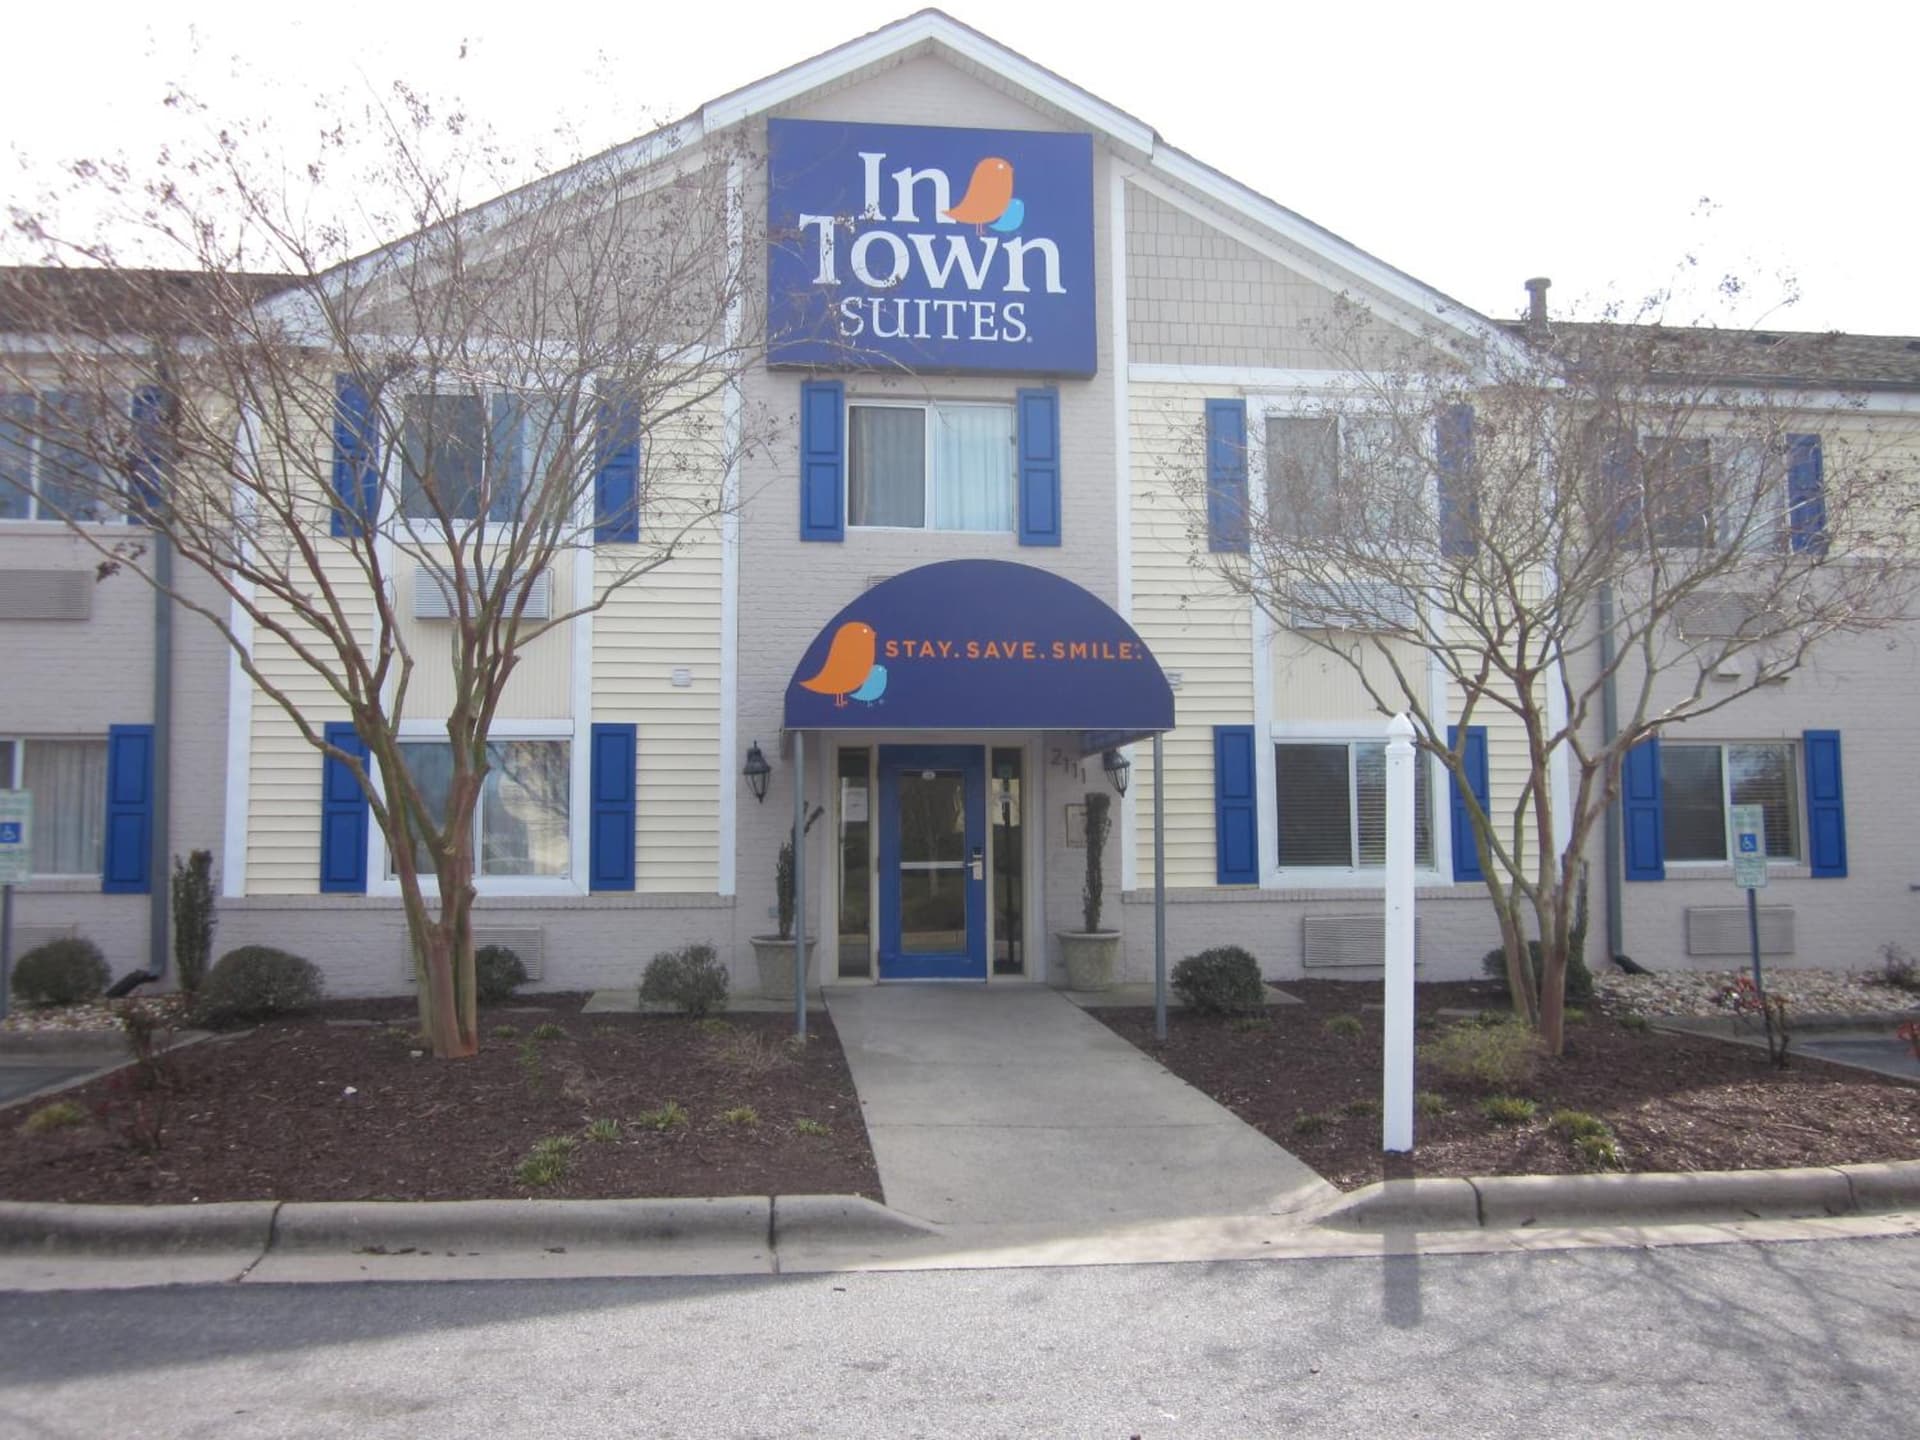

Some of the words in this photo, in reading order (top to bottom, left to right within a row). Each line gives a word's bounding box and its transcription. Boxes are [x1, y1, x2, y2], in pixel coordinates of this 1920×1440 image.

[858, 151, 956, 224] In
[799, 213, 1067, 293] Town
[839, 295, 1027, 342] SUITES
[885, 640, 960, 658] STAY.
[966, 640, 1045, 659] SAVE.
[1052, 641, 1142, 660] SMILE.
